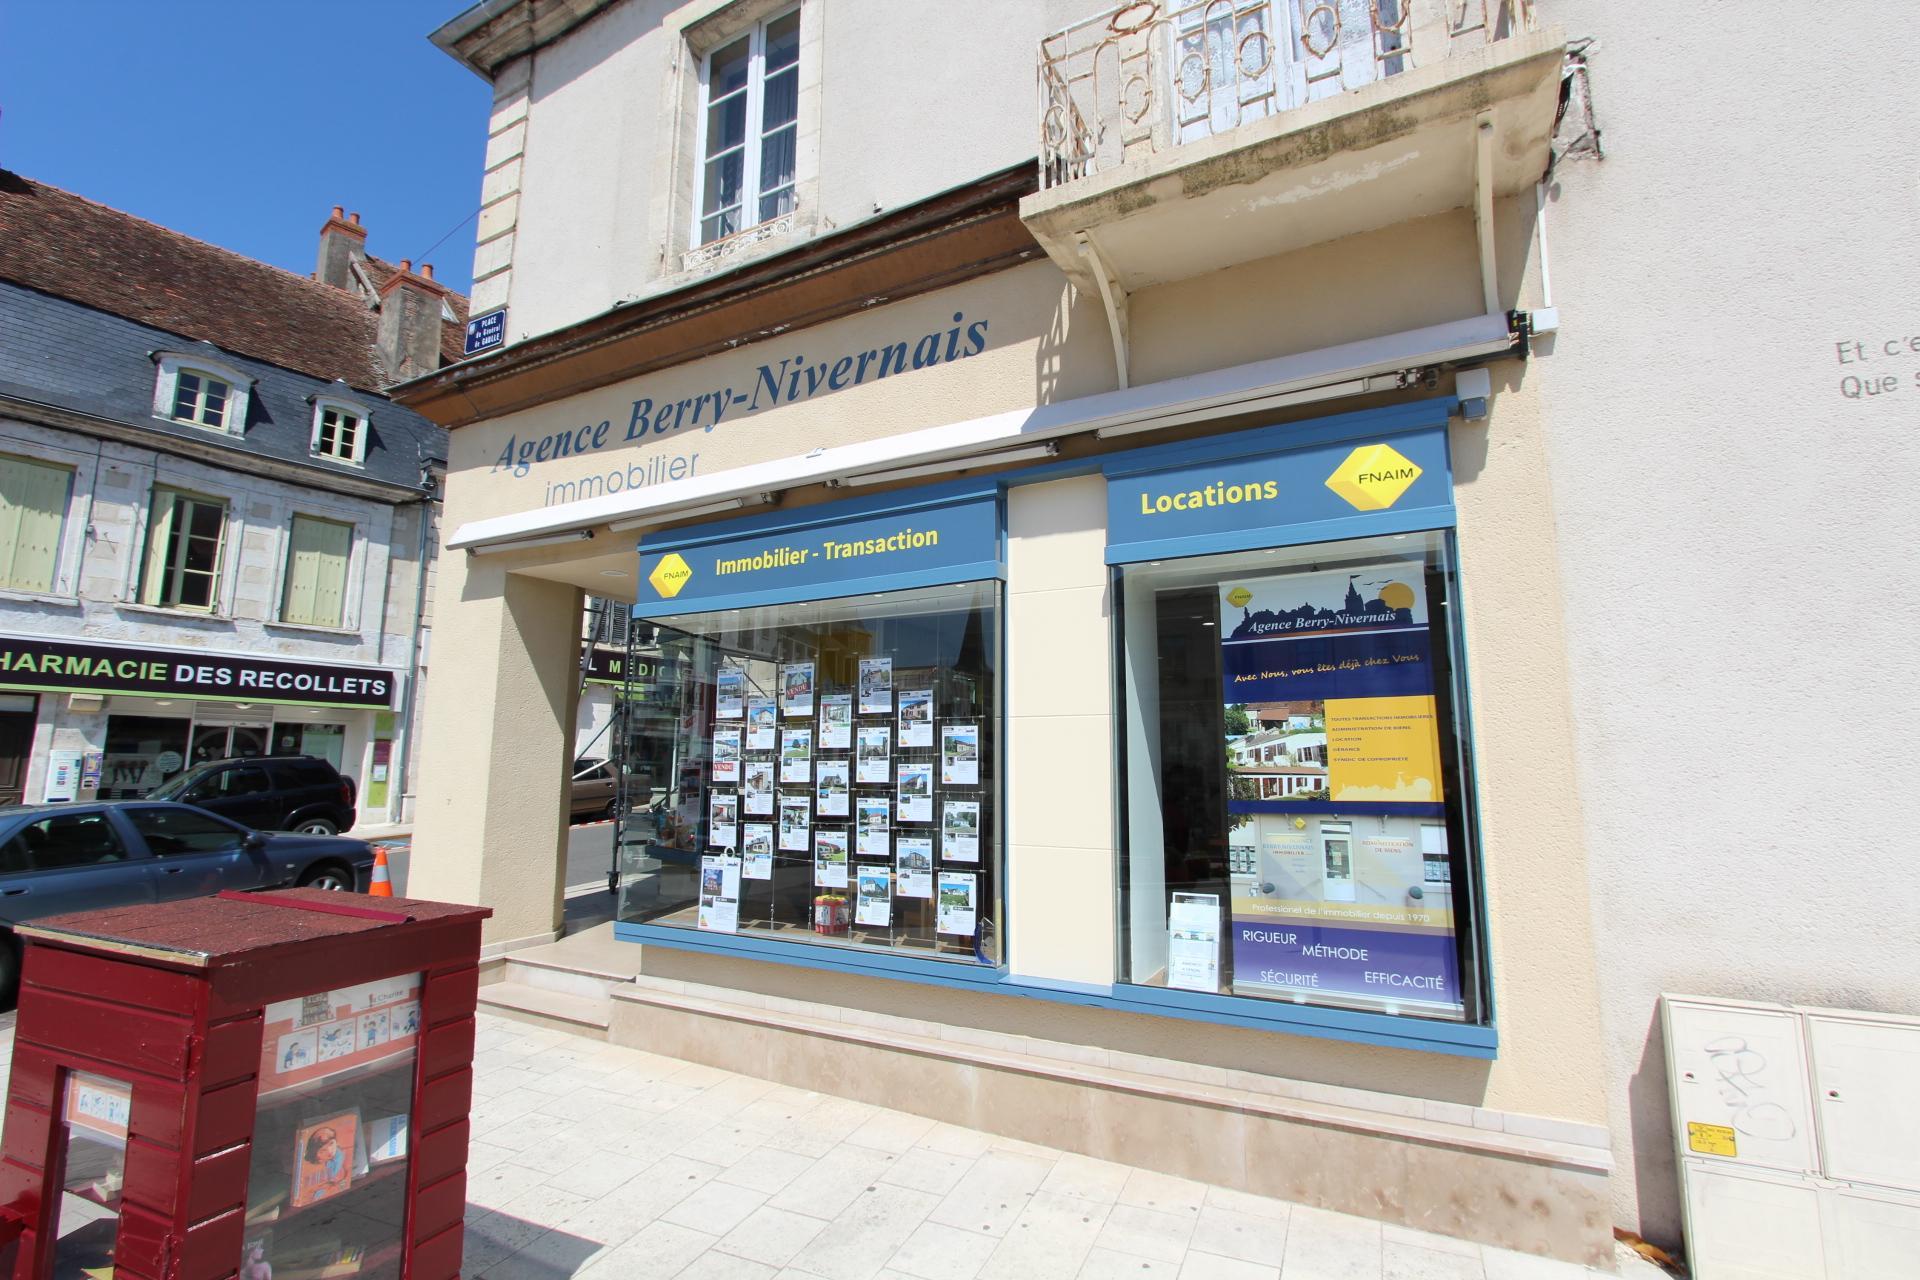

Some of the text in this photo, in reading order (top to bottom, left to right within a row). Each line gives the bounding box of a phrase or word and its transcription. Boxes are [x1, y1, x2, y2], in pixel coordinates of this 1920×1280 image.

[482, 316, 497, 328] PLACE
[481, 333, 500, 345] GAULLE
[1836, 340, 1869, 365] Et
[490, 312, 988, 478] Agence Berry-Nivernais
[1841, 375, 1898, 399] Que
[545, 453, 699, 508] immobilier
[1141, 467, 1414, 515] Locations FNAIM
[716, 548, 808, 576] Immobilier
[823, 528, 938, 560] Transaction
[663, 570, 689, 580] FNAIM
[1248, 610, 1397, 634] Agence Berry-Nivernais
[175, 664, 232, 686] DES
[239, 669, 387, 696] RECOLLETS
[1234, 674, 1257, 683] Avec
[1291, 668, 1314, 676] vous
[1317, 663, 1336, 672] êtes
[1339, 658, 1361, 671] déjà
[1364, 656, 1390, 667] chez
[787, 682, 808, 696] VENDU
[1304, 906, 1317, 915] de
[1373, 912, 1405, 922] depuis
[1407, 913, 1430, 922] 1970
[1243, 930, 1297, 945] RIGUEUR
[1302, 943, 1369, 962] MÉTHODE
[1260, 968, 1319, 987] SÉCURITÉ
[1364, 971, 1445, 991] EFFICACITÉ
